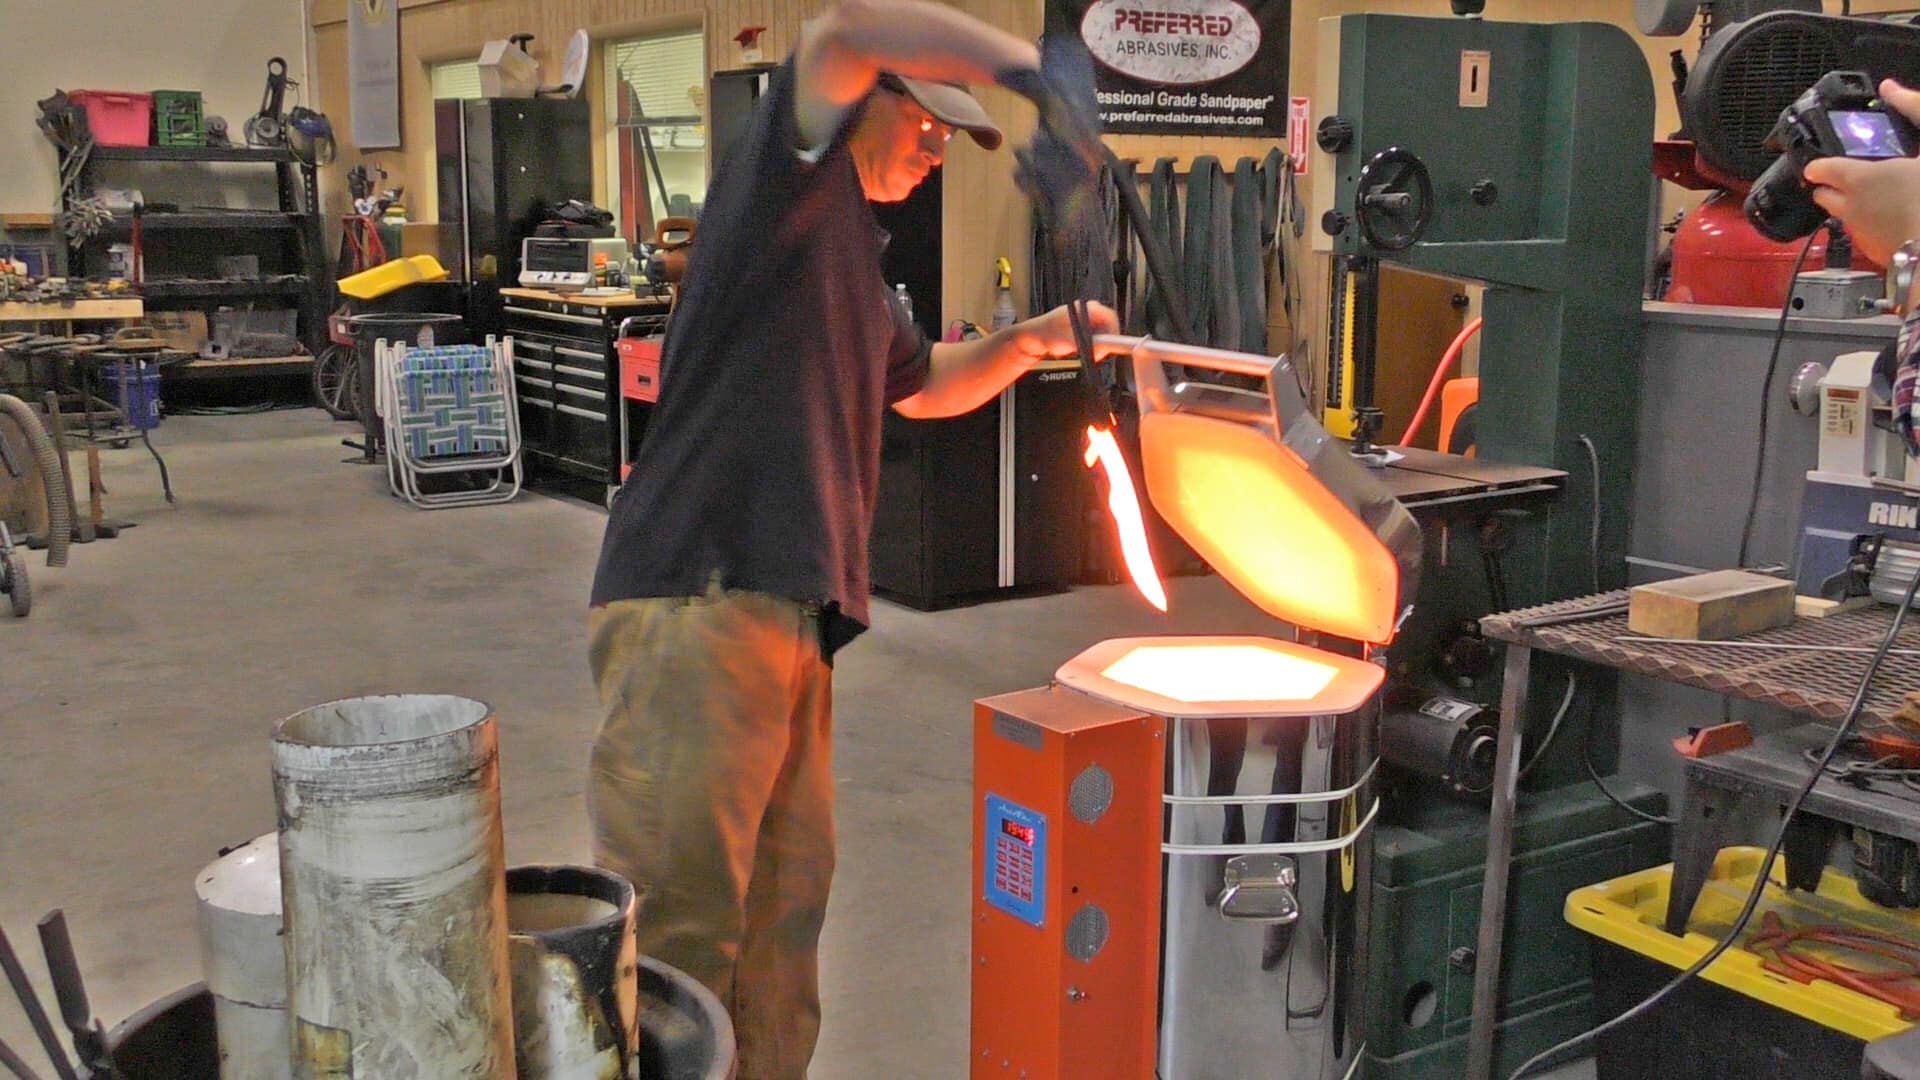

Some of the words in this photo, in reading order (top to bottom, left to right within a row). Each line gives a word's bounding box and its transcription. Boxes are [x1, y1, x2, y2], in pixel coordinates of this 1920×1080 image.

[1114, 9, 1233, 37] PREFERRED
[1116, 40, 1201, 58] ABRASIVES,
[1205, 45, 1232, 60] INC.
[1095, 88, 1154, 105] essional
[1157, 91, 1198, 107] Grade
